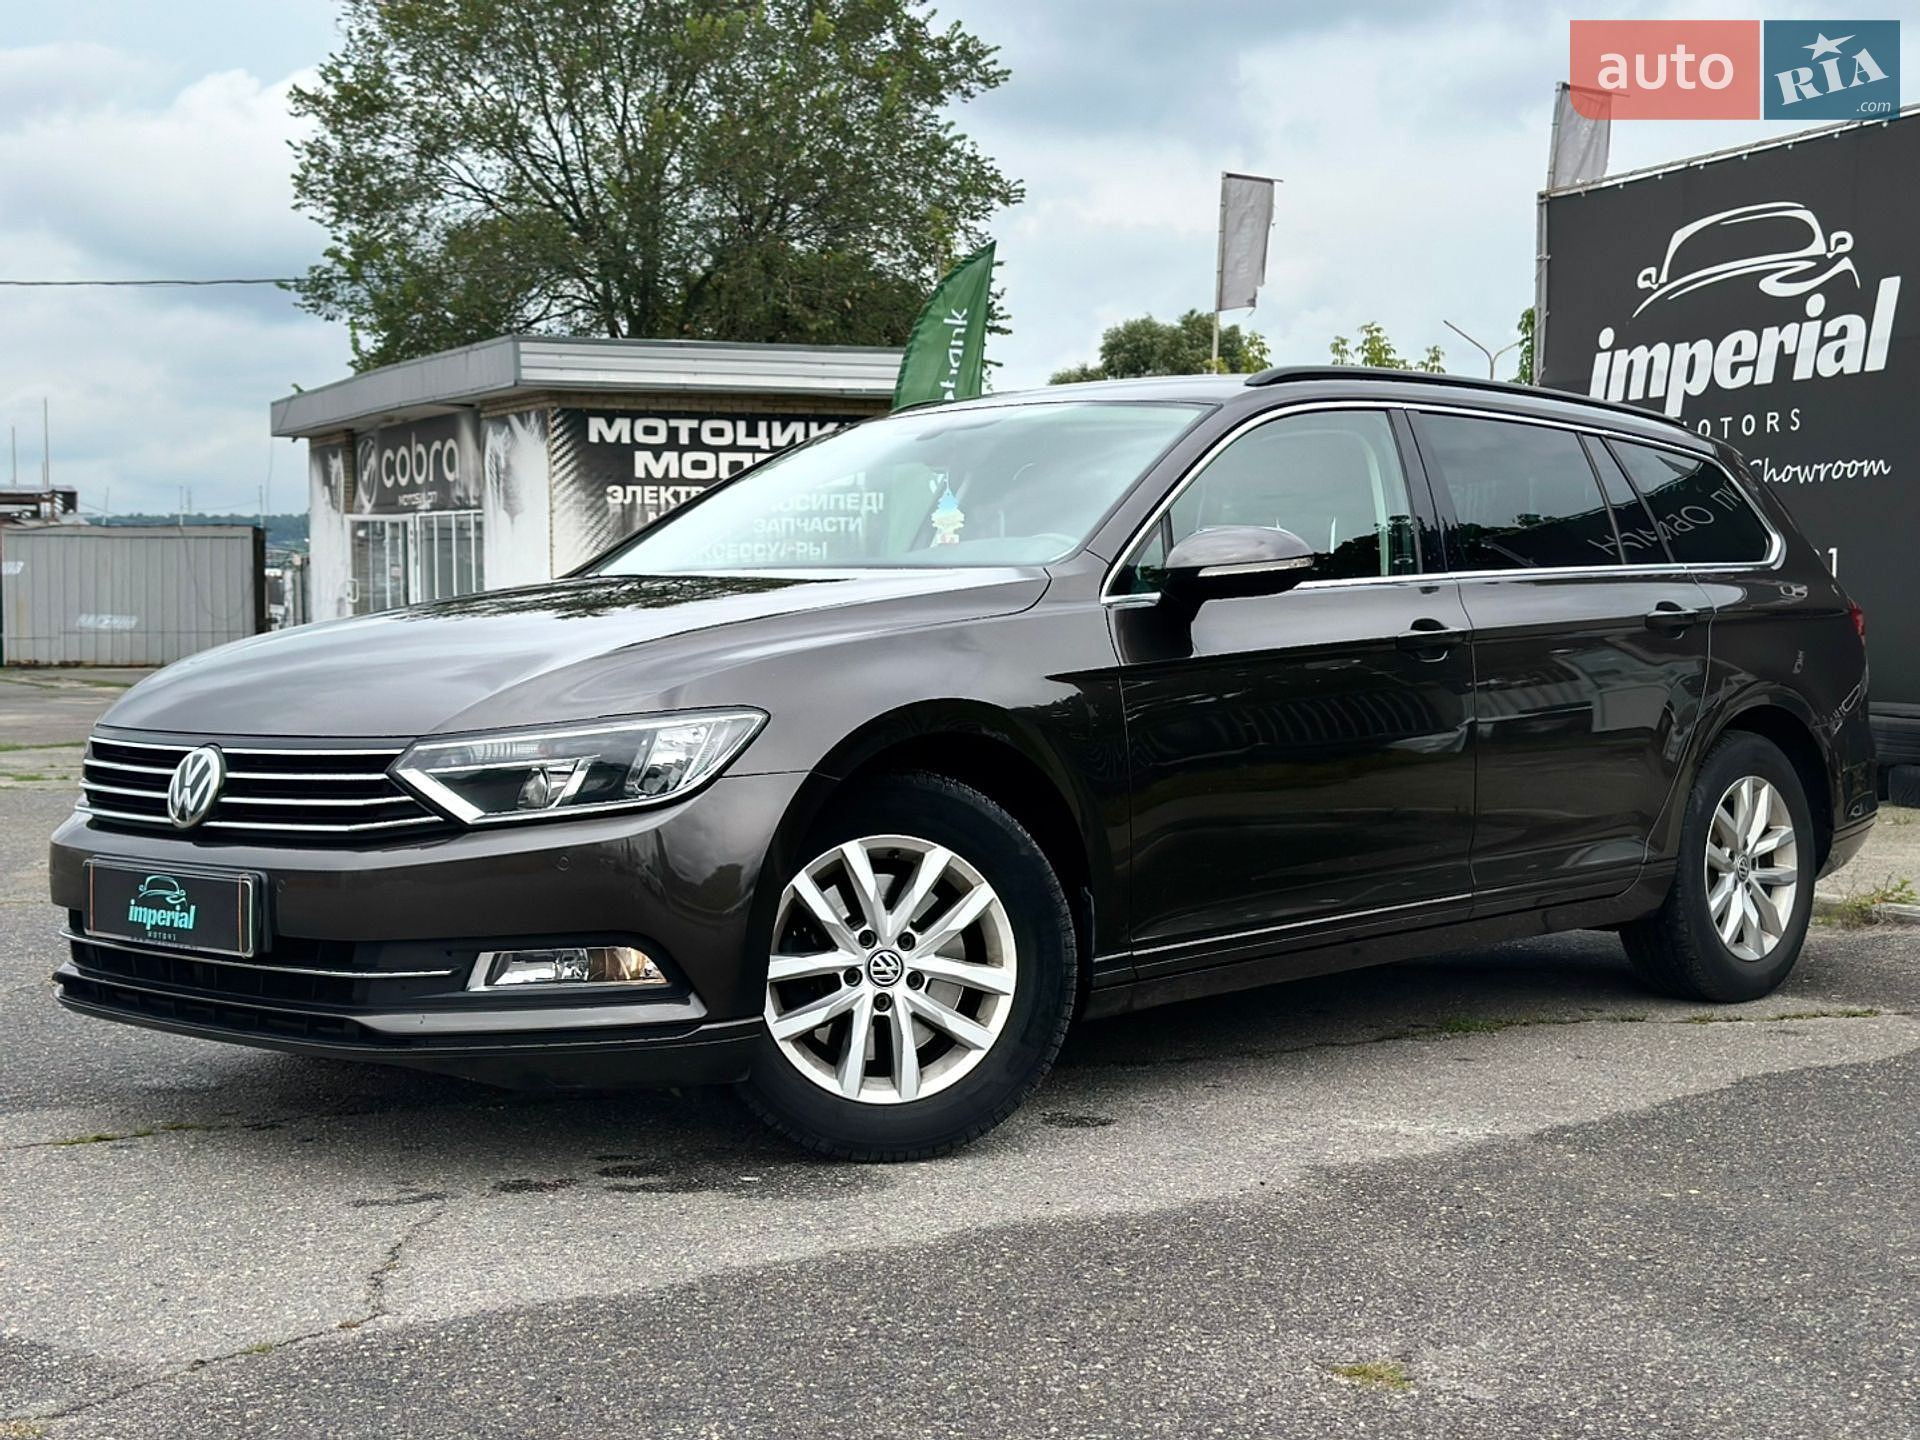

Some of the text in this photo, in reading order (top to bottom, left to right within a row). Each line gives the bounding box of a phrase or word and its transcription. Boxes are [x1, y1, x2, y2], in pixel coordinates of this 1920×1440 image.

[1588, 275, 1901, 418] imperial
[588, 417, 848, 450] МОТОЦИК
[1684, 408, 1801, 439] OTORS
[382, 431, 460, 488] cobra
[634, 451, 777, 480] МОП
[128, 898, 196, 930] imperial
